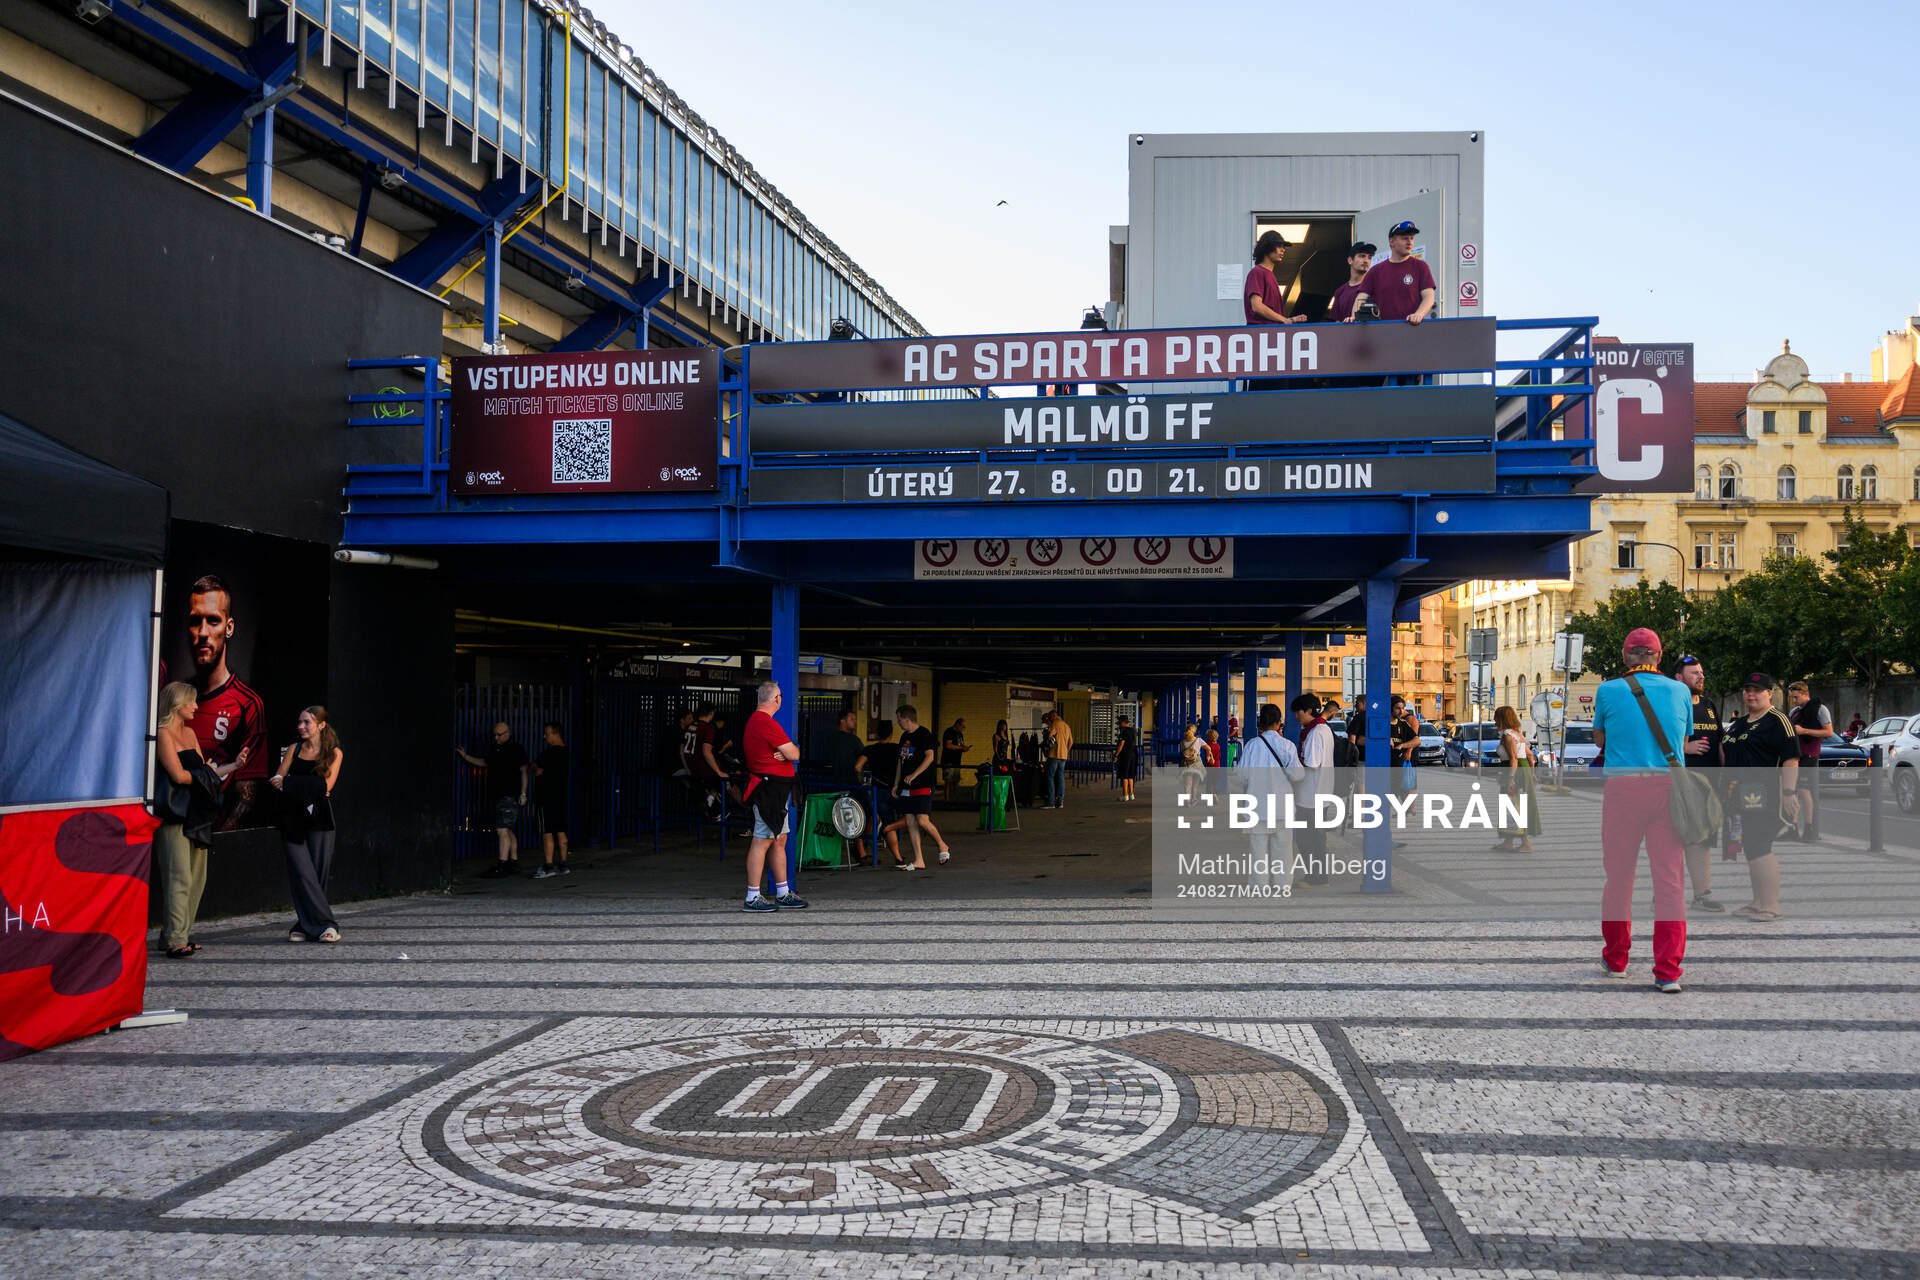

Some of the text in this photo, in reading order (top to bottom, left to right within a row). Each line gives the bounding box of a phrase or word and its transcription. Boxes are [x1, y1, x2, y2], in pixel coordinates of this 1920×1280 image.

[904, 330, 1317, 382] AC SPARTA PRAHA
[1643, 350, 1685, 366] GATE
[467, 359, 700, 391] VSTUPENKY ONLINE
[484, 391, 684, 416] MATCH TICKETS ONLINE
[1003, 396, 1214, 444] MALMÖ FF
[1596, 378, 1663, 481] C
[867, 465, 953, 497] ÚTERÝ
[987, 470, 1026, 496] 27.
[1050, 469, 1076, 495] 8.
[1107, 467, 1142, 494] OD
[1168, 467, 1205, 492] 21.
[1283, 463, 1373, 490] HODIN
